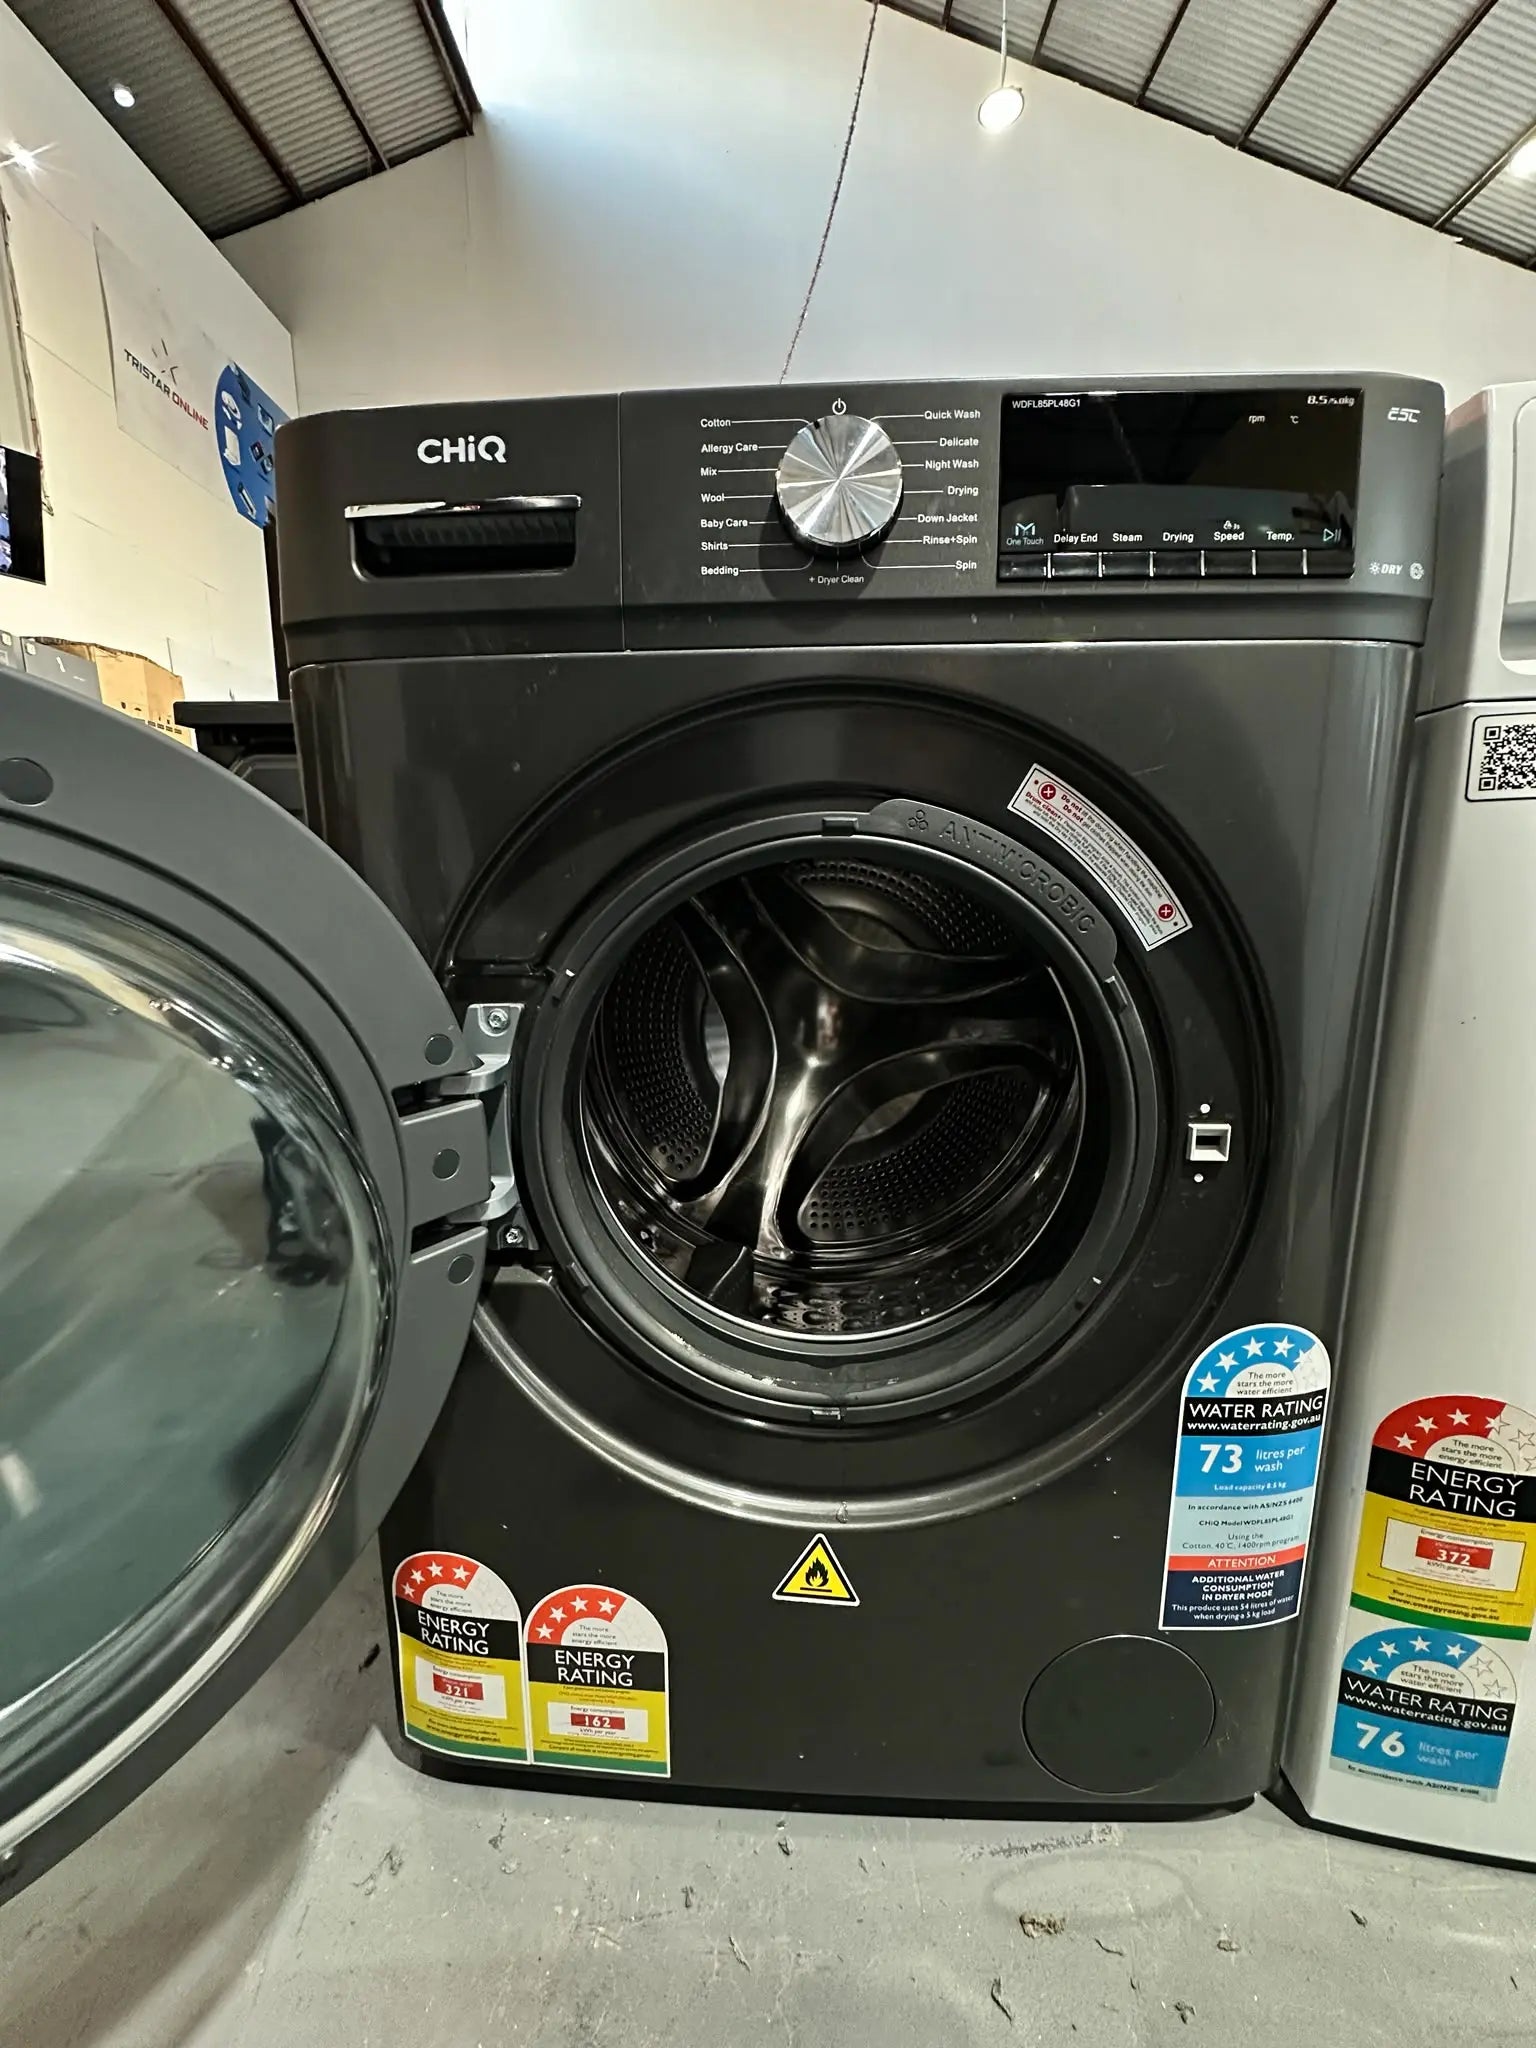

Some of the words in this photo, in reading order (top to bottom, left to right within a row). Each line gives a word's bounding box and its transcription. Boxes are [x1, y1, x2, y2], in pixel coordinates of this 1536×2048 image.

[124, 348, 170, 399] TRISTAR
[172, 393, 208, 430] ONLINE
[1012, 399, 1081, 409] WDFL85PL48G1
[924, 410, 952, 420] Quick
[953, 410, 981, 419] Wash
[1248, 415, 1265, 424] rpm
[700, 418, 731, 428] Cotton
[939, 437, 979, 446] Delicate
[417, 435, 507, 464] CHiQ
[701, 444, 734, 454] Allergy
[735, 443, 758, 451] Care
[700, 467, 717, 476] Mix
[925, 459, 950, 471] Night
[952, 459, 979, 468] Wash
[701, 493, 725, 502] Wool
[947, 486, 979, 497] Drying
[700, 519, 724, 529] Baby
[725, 519, 748, 527] Care
[917, 514, 944, 523] Down
[946, 513, 978, 523] Jacket
[922, 535, 978, 545] Rinse+Spin
[1006, 537, 1021, 546] One
[1023, 536, 1044, 545] Touch
[1054, 533, 1078, 544] Delay
[1080, 533, 1098, 543] End
[1112, 532, 1143, 542] Steam
[1162, 531, 1194, 544] Drying
[1213, 531, 1245, 543] Speed
[1266, 531, 1295, 541] Temp.
[701, 541, 729, 550] Shirts
[701, 566, 739, 576] Bedding
[955, 560, 977, 570] Spin
[1381, 563, 1403, 575] DRY
[817, 575, 839, 585] Dryer
[841, 575, 864, 583] Clean
[1025, 791, 1042, 805] Drum
[1061, 794, 1070, 803] Do
[1071, 803, 1082, 812] not
[1063, 804, 1072, 813] Do
[1072, 813, 1083, 822] not
[1189, 1403, 1255, 1418] WATER
[1261, 1395, 1323, 1417] RATING
[1187, 1414, 1321, 1431] www.waterrating.gov.au
[1452, 1439, 1470, 1448] The
[1471, 1442, 1495, 1451] more
[1199, 1443, 1243, 1474] 73
[1256, 1449, 1285, 1459] litres
[1286, 1446, 1305, 1458] per
[1441, 1446, 1462, 1455] stars
[1463, 1449, 1477, 1457] the
[1479, 1452, 1503, 1460] more
[1254, 1460, 1283, 1473] wash
[1438, 1454, 1467, 1464] energy
[1469, 1458, 1503, 1469] efficient
[1411, 1461, 1524, 1496] ENERGY
[1234, 1484, 1265, 1492] capacity
[1409, 1483, 1517, 1518] RATING
[1228, 1533, 1250, 1541] Using
[1271, 1535, 1300, 1547] program
[1207, 1555, 1276, 1568] ATTENTION
[1436, 1549, 1471, 1566] 372
[1191, 1575, 1254, 1583] ADDITIONAL
[1255, 1570, 1285, 1581] WATER
[1202, 1581, 1274, 1592] CONSUMPTION
[1214, 1593, 1245, 1601] DRYER
[1247, 1589, 1273, 1599] MODE
[1240, 1601, 1249, 1610] 54
[1250, 1601, 1268, 1609] litres
[1269, 1598, 1278, 1606] of
[1277, 1594, 1295, 1604] water
[1252, 1610, 1260, 1619] kg
[1261, 1607, 1275, 1616] load
[417, 1609, 490, 1638] ENERGY
[421, 1627, 489, 1655] RATING
[555, 1649, 635, 1670] ENERGY
[557, 1667, 633, 1687] RATING
[1412, 1663, 1430, 1674] The
[1431, 1670, 1456, 1679] more
[1400, 1670, 1422, 1681] stars
[1423, 1674, 1439, 1684] the
[1440, 1678, 1464, 1687] more
[445, 1684, 468, 1698] 321
[1400, 1677, 1427, 1689] water
[1427, 1680, 1462, 1694] efficient
[1346, 1676, 1423, 1708] WATER
[1429, 1697, 1508, 1721] RATING
[1344, 1692, 1507, 1732] www.waterrating.gov.au
[584, 1715, 611, 1728] 162
[1356, 1721, 1405, 1757] 76
[1418, 1741, 1451, 1756] litres
[1454, 1750, 1479, 1761] per
[1417, 1753, 1450, 1766] wash
